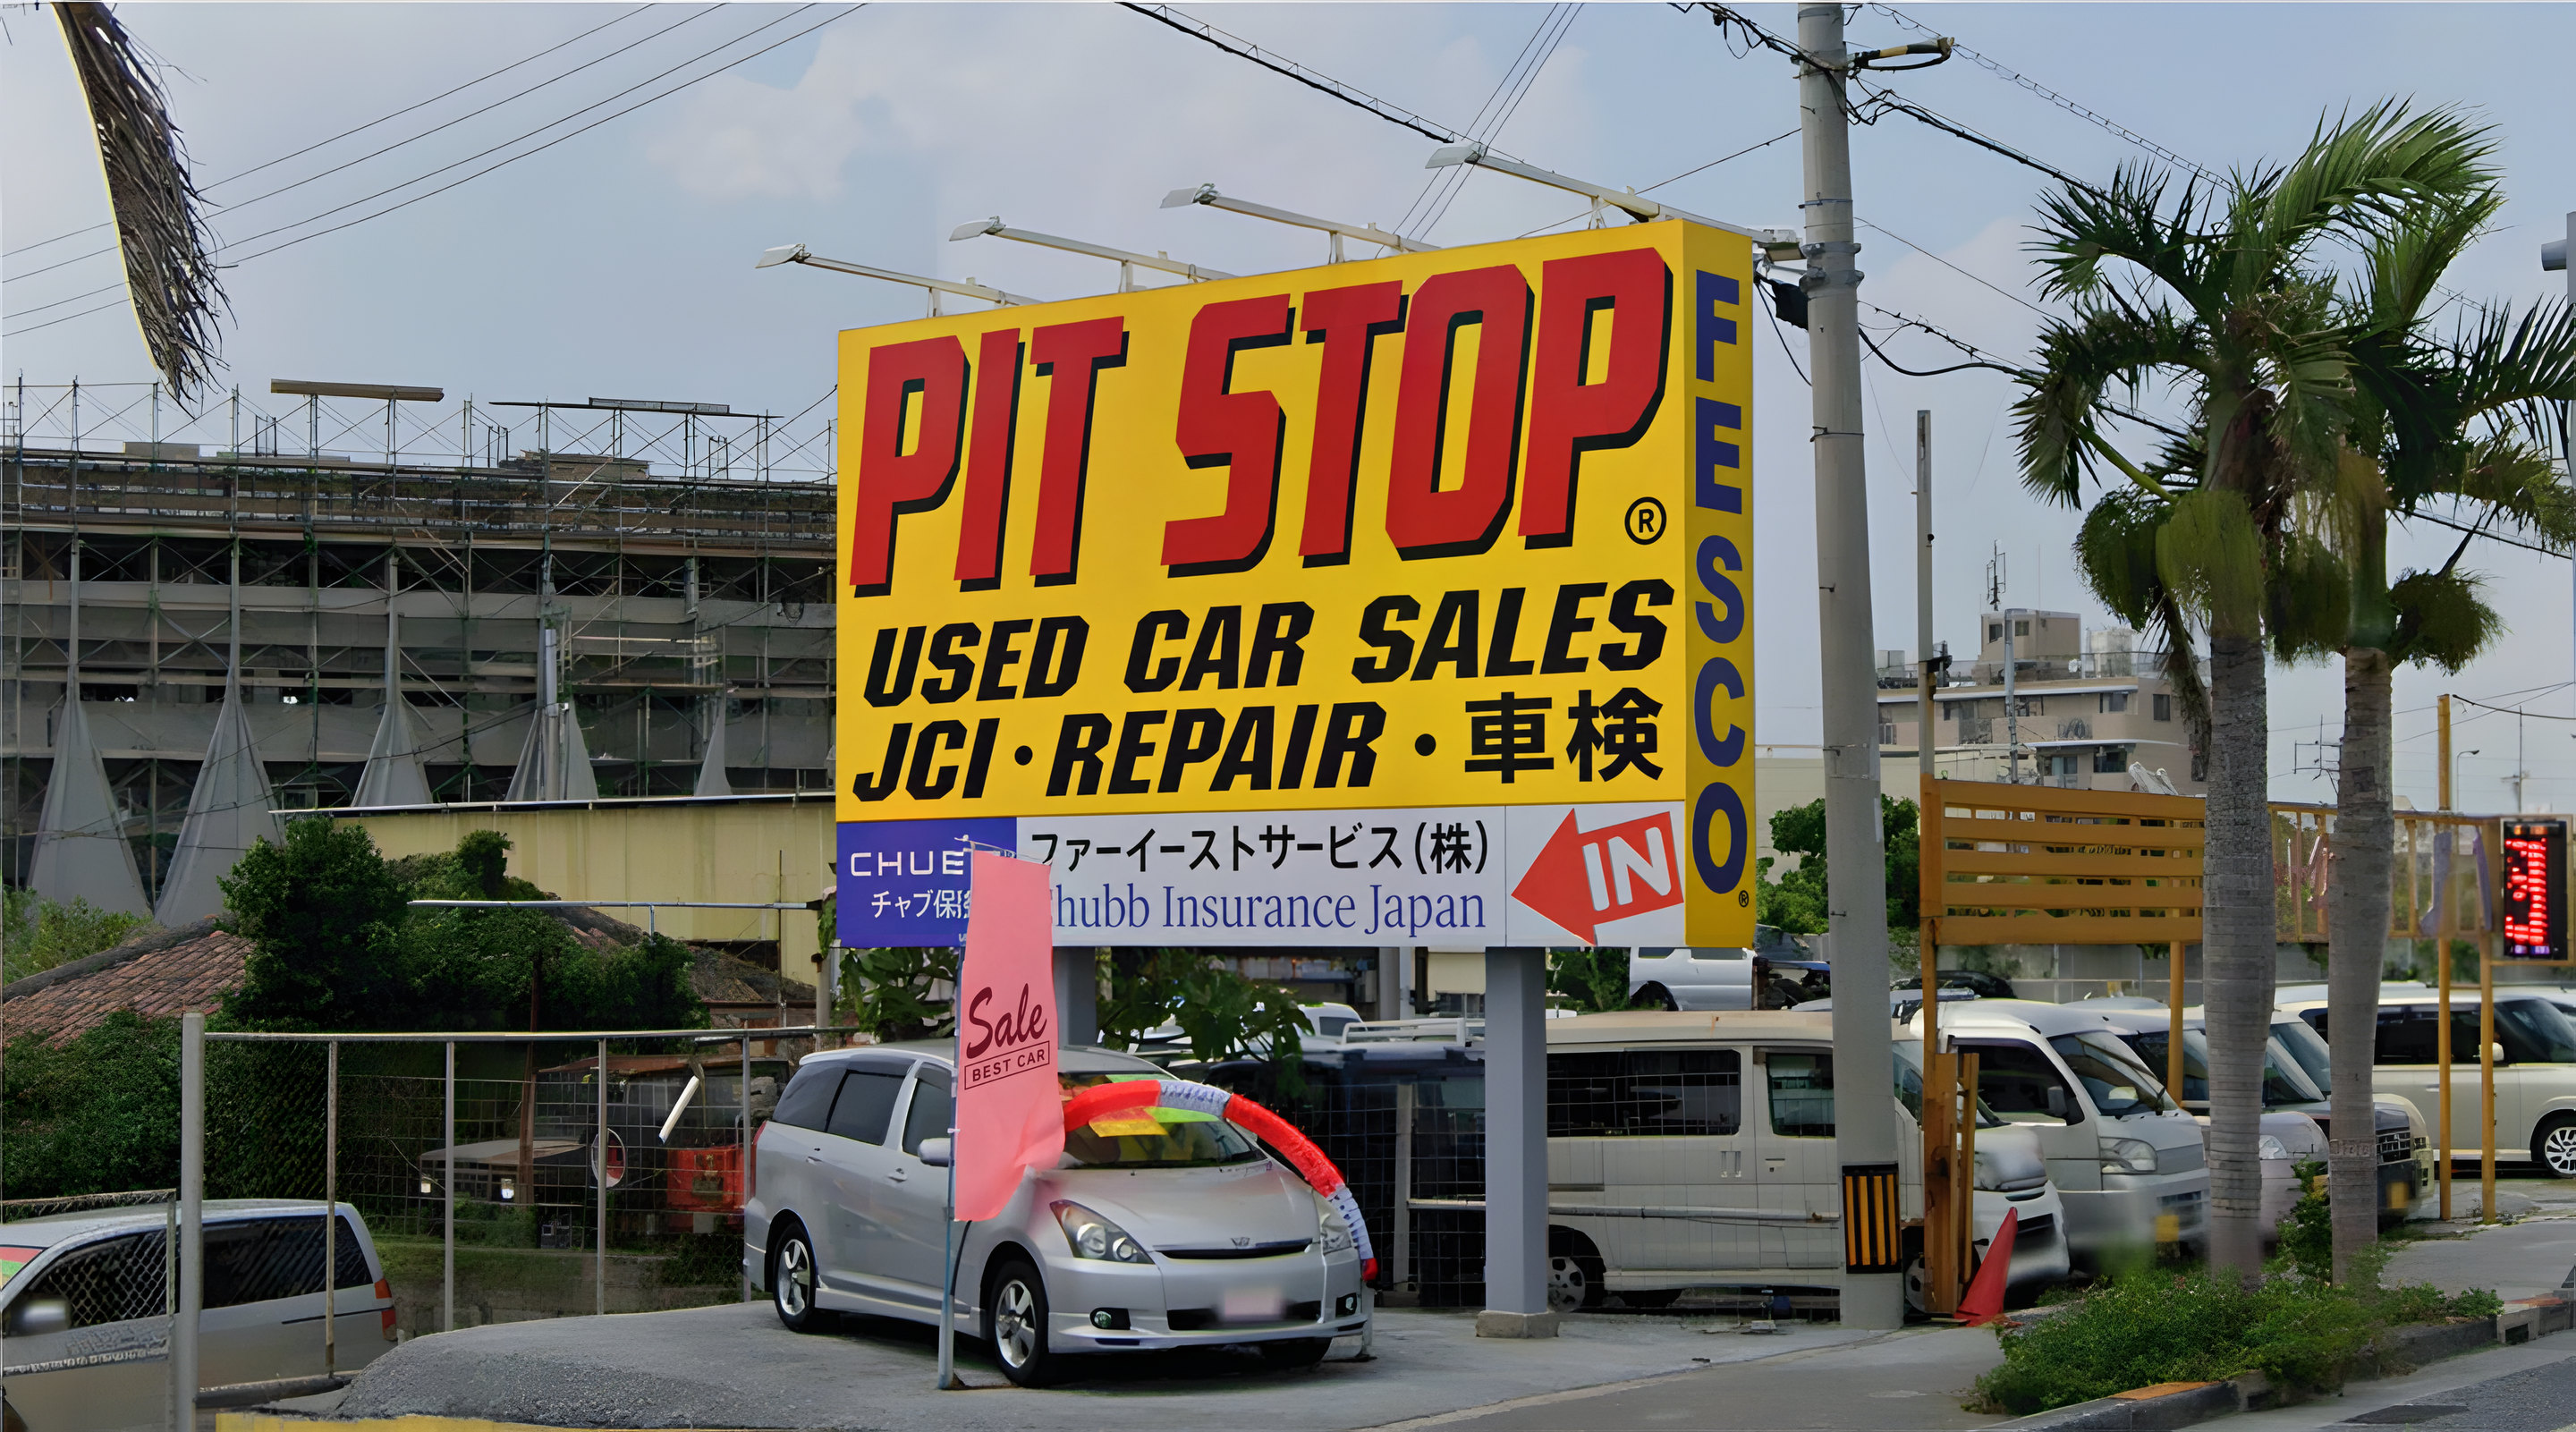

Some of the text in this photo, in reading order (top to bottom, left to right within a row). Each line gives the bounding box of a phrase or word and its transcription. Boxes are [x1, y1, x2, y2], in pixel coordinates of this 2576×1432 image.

[850, 247, 1674, 598] PIT STOP
[1692, 269, 1748, 894] FESCO
[864, 579, 1674, 708] USED CAR SALES
[1050, 883, 1487, 938] hubb Insurance Japan
[1581, 826, 1673, 912] IN
[966, 983, 1047, 1059] Sale
[972, 1048, 1046, 1082] BEST CAR
